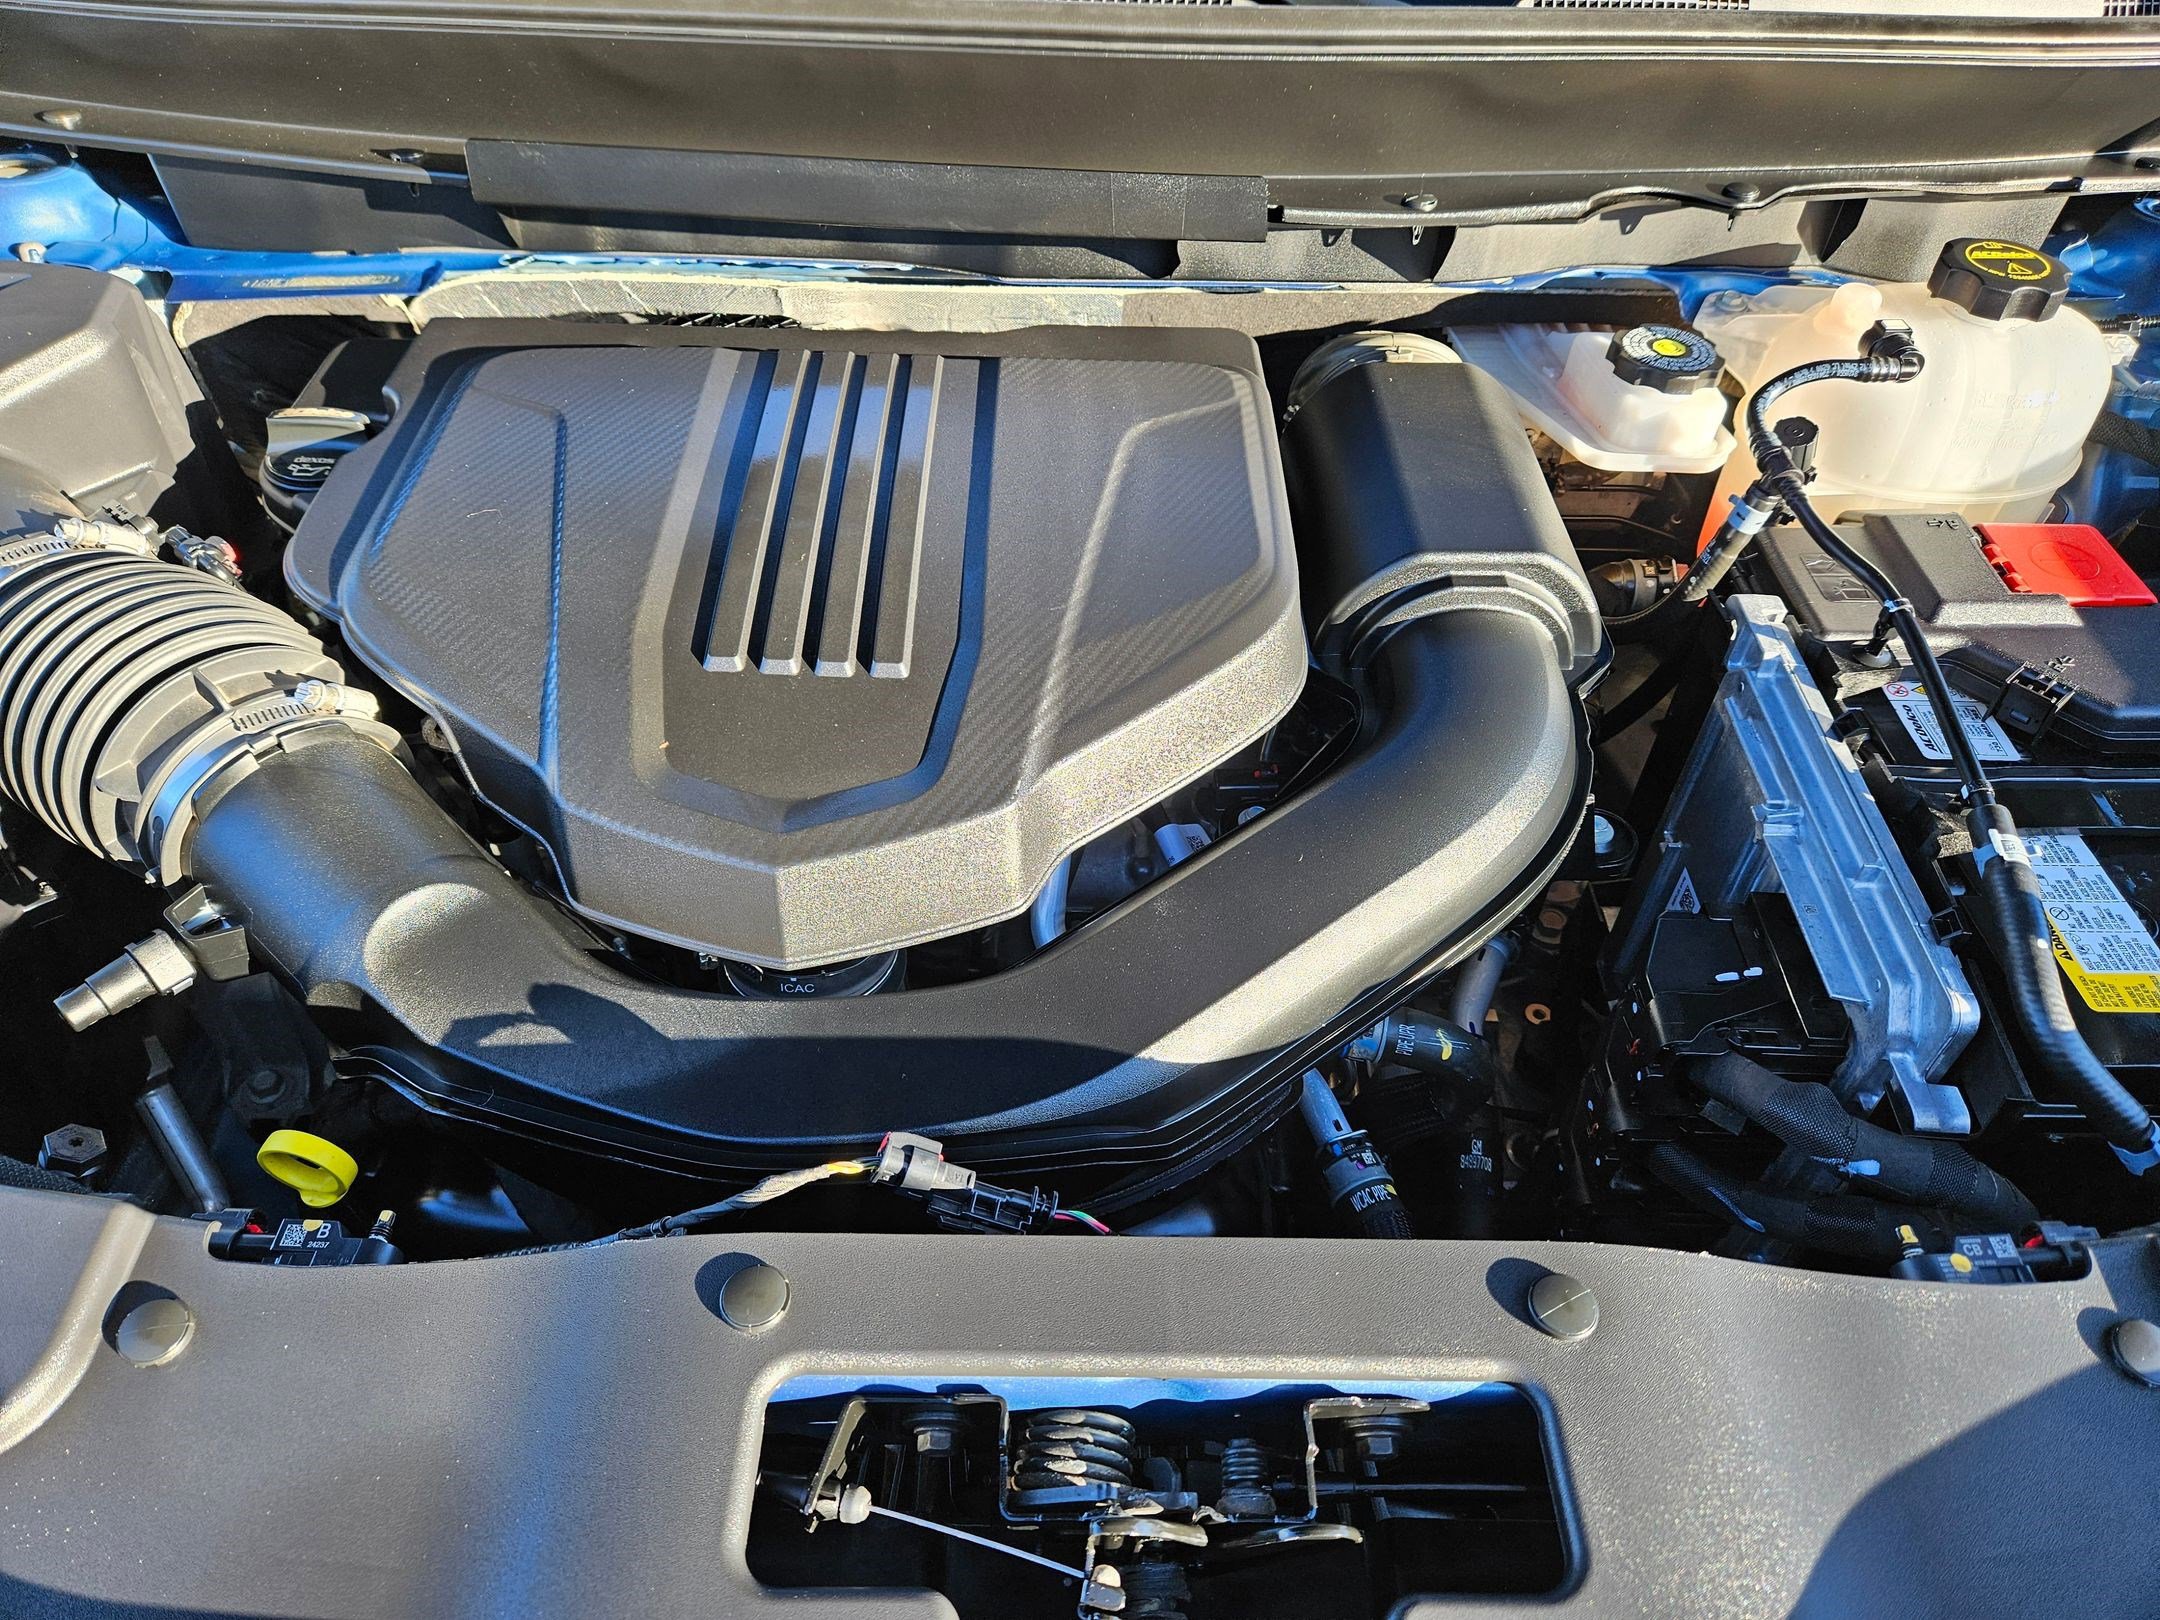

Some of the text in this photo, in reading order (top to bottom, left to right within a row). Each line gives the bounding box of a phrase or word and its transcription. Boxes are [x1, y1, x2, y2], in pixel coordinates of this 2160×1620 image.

[293, 455, 336, 464] dexos
[1902, 704, 1938, 752] ACDelco
[780, 983, 815, 993] ICAC
[1395, 1024, 1416, 1056] PIPE UPR
[316, 1223, 331, 1239] B
[1962, 1243, 1983, 1256] CB
